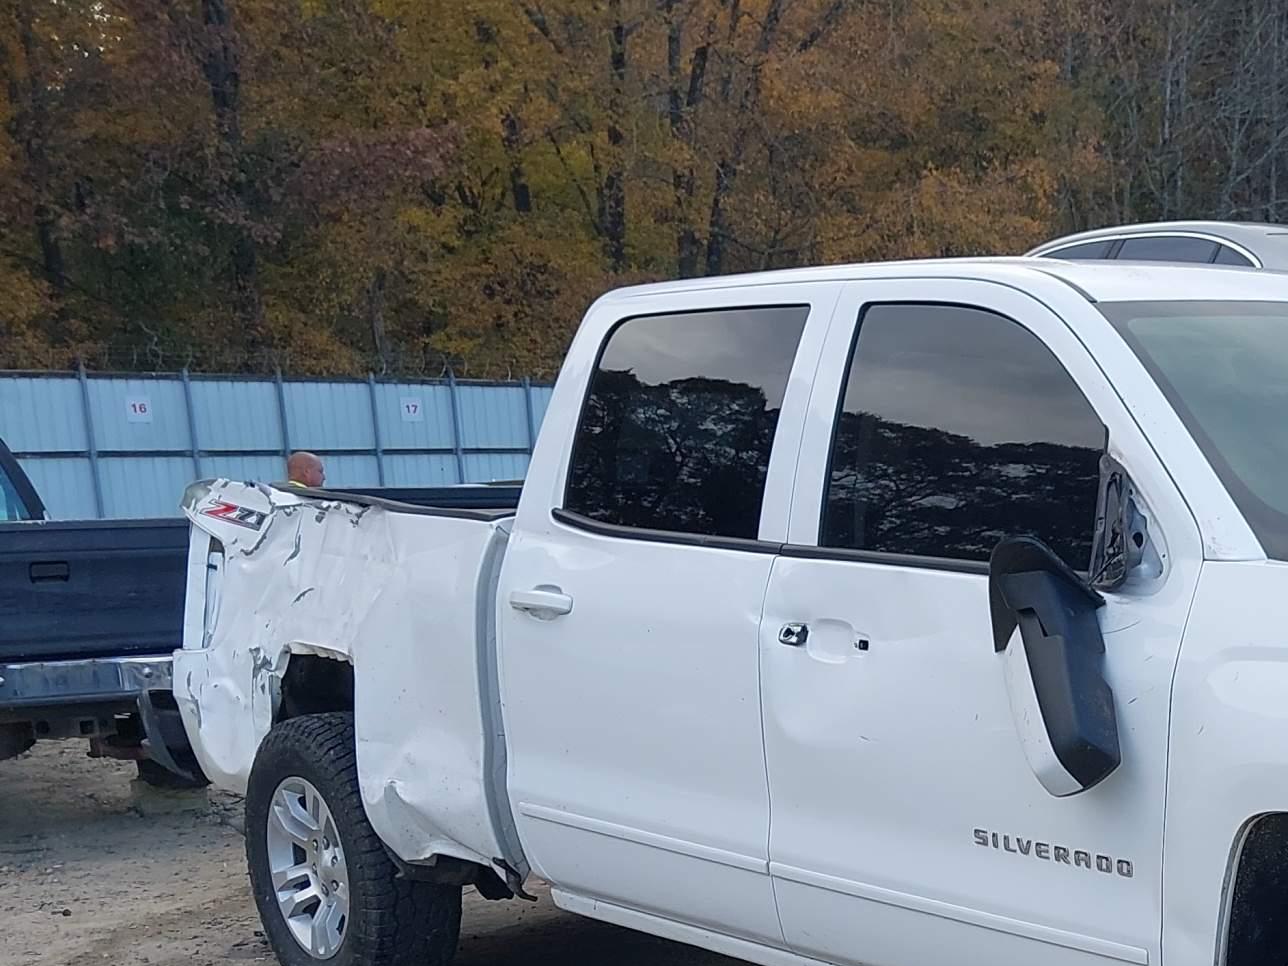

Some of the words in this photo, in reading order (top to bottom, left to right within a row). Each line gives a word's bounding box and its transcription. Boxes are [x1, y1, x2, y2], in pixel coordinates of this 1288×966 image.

[131, 403, 147, 414] 16
[405, 404, 418, 414] 17
[200, 499, 268, 531] Z71
[973, 828, 1134, 878] SILVERADO
